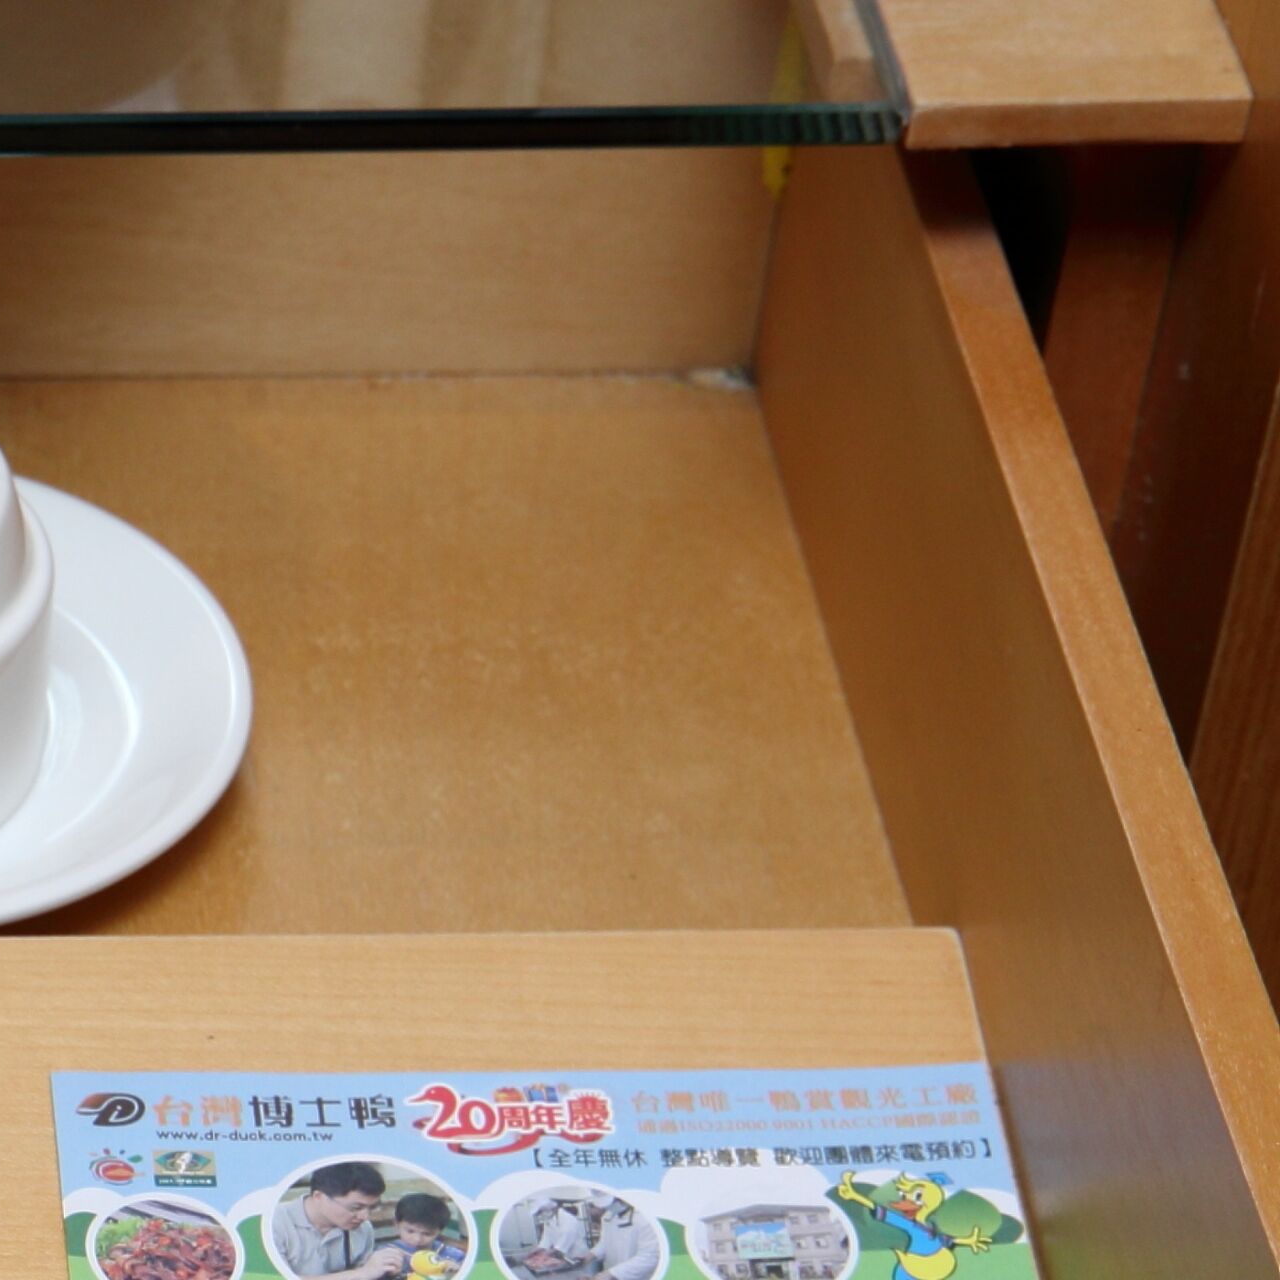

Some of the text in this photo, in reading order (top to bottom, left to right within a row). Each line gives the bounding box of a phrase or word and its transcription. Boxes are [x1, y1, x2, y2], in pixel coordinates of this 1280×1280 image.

[153, 1094, 396, 1129] 台灣博士鴨
[155, 1129, 333, 1142] www.dr-duck.com.tw
